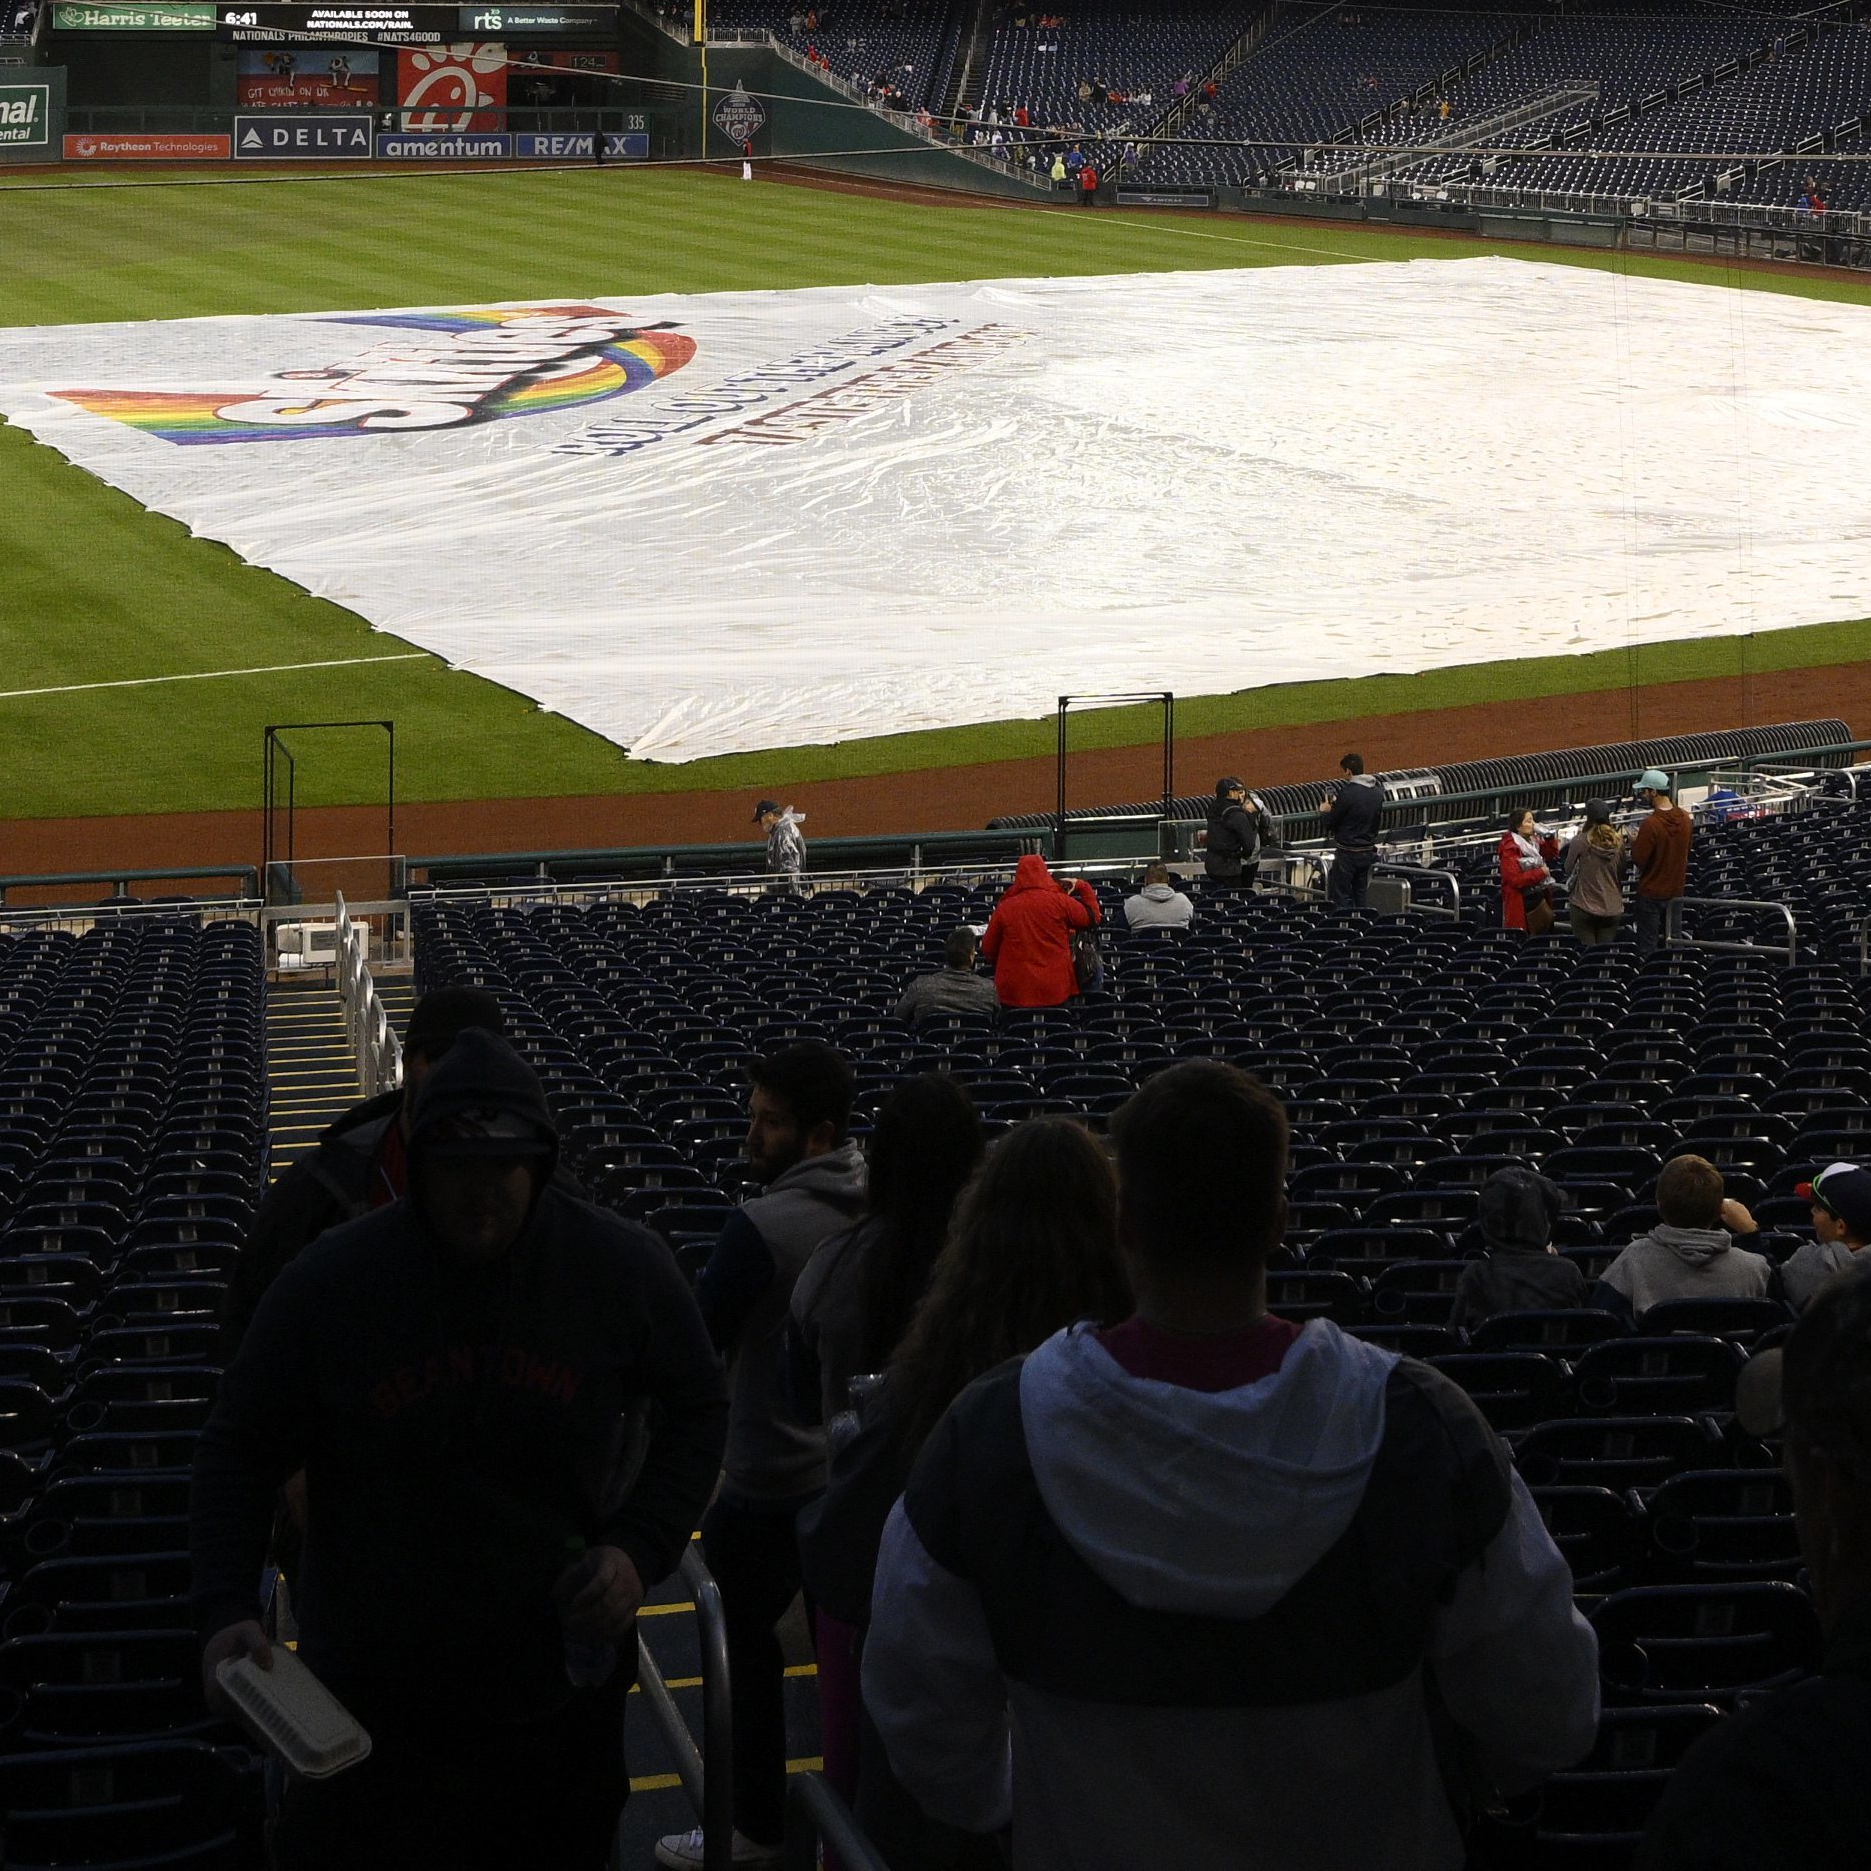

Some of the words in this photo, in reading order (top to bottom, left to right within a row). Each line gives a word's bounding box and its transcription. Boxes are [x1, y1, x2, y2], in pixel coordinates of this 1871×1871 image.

[84, 10, 146, 27] Harris
[149, 10, 209, 27] Teeter
[225, 12, 257, 26] 6:41
[311, 10, 364, 19] AVAILABLE
[364, 10, 393, 19] SOON
[394, 10, 409, 19] ON
[474, 11, 502, 30] rts
[232, 30, 286, 41] NATIONALS
[288, 30, 369, 42] PHILANTHROPIES
[377, 32, 441, 42] #NATS4GOOD
[628, 115, 645, 130] 335
[273, 127, 367, 146] DELTA
[100, 141, 151, 154] Raytheon
[153, 142, 219, 154] Technologies
[386, 138, 503, 157] amentum
[549, 415, 717, 456] ROLL
[650, 382, 788, 413] OUT
